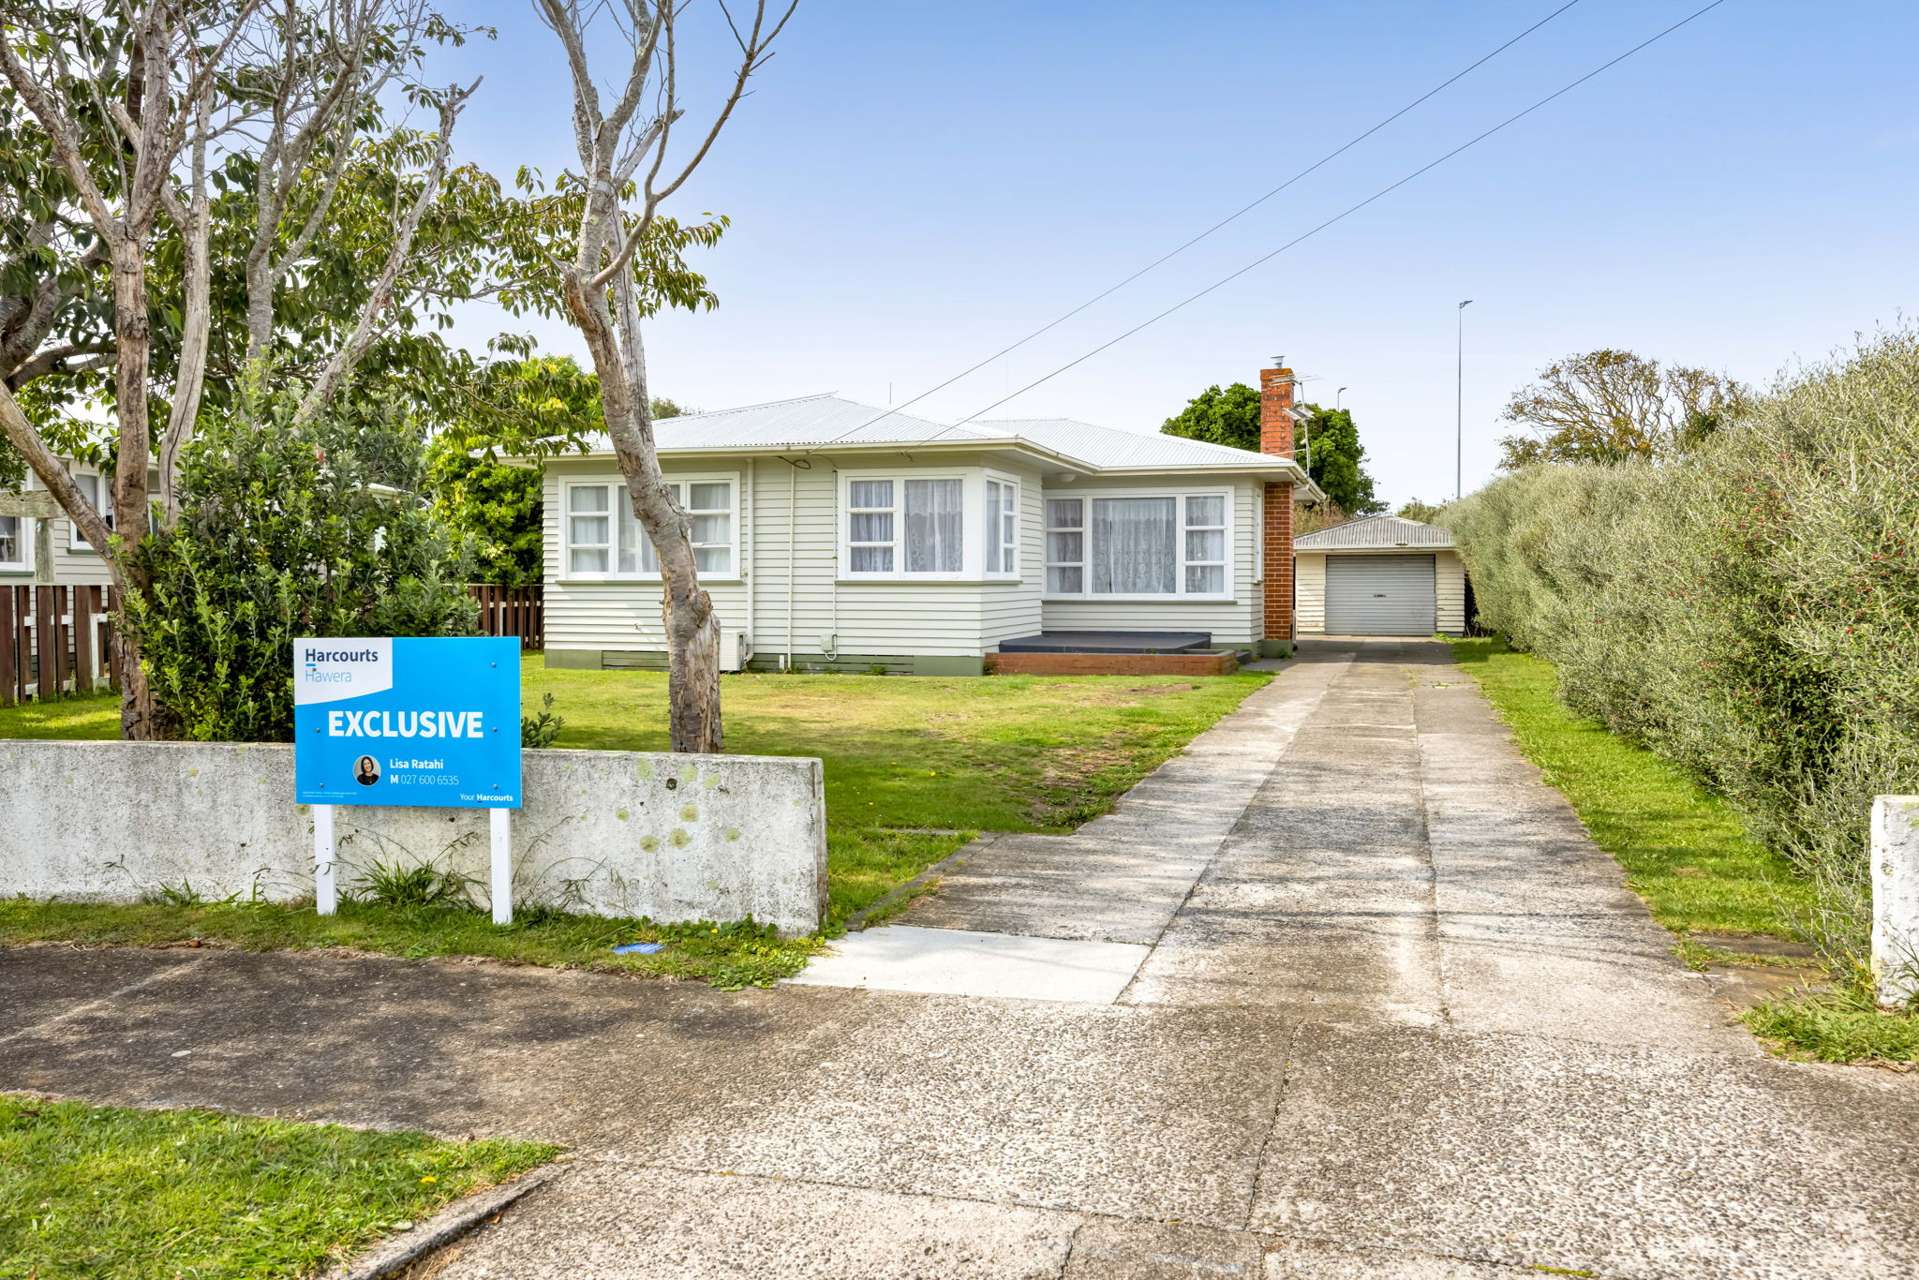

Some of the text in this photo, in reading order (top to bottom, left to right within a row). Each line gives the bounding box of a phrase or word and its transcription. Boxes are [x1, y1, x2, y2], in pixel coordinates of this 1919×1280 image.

[305, 648, 379, 662] Harcourts
[305, 670, 353, 683] Hawera
[328, 710, 484, 738] EXCLUSIVE
[389, 758, 444, 769] Lisa Ratahi
[390, 774, 460, 786] M 027 600 6535
[460, 793, 513, 802] Your Harcourts
